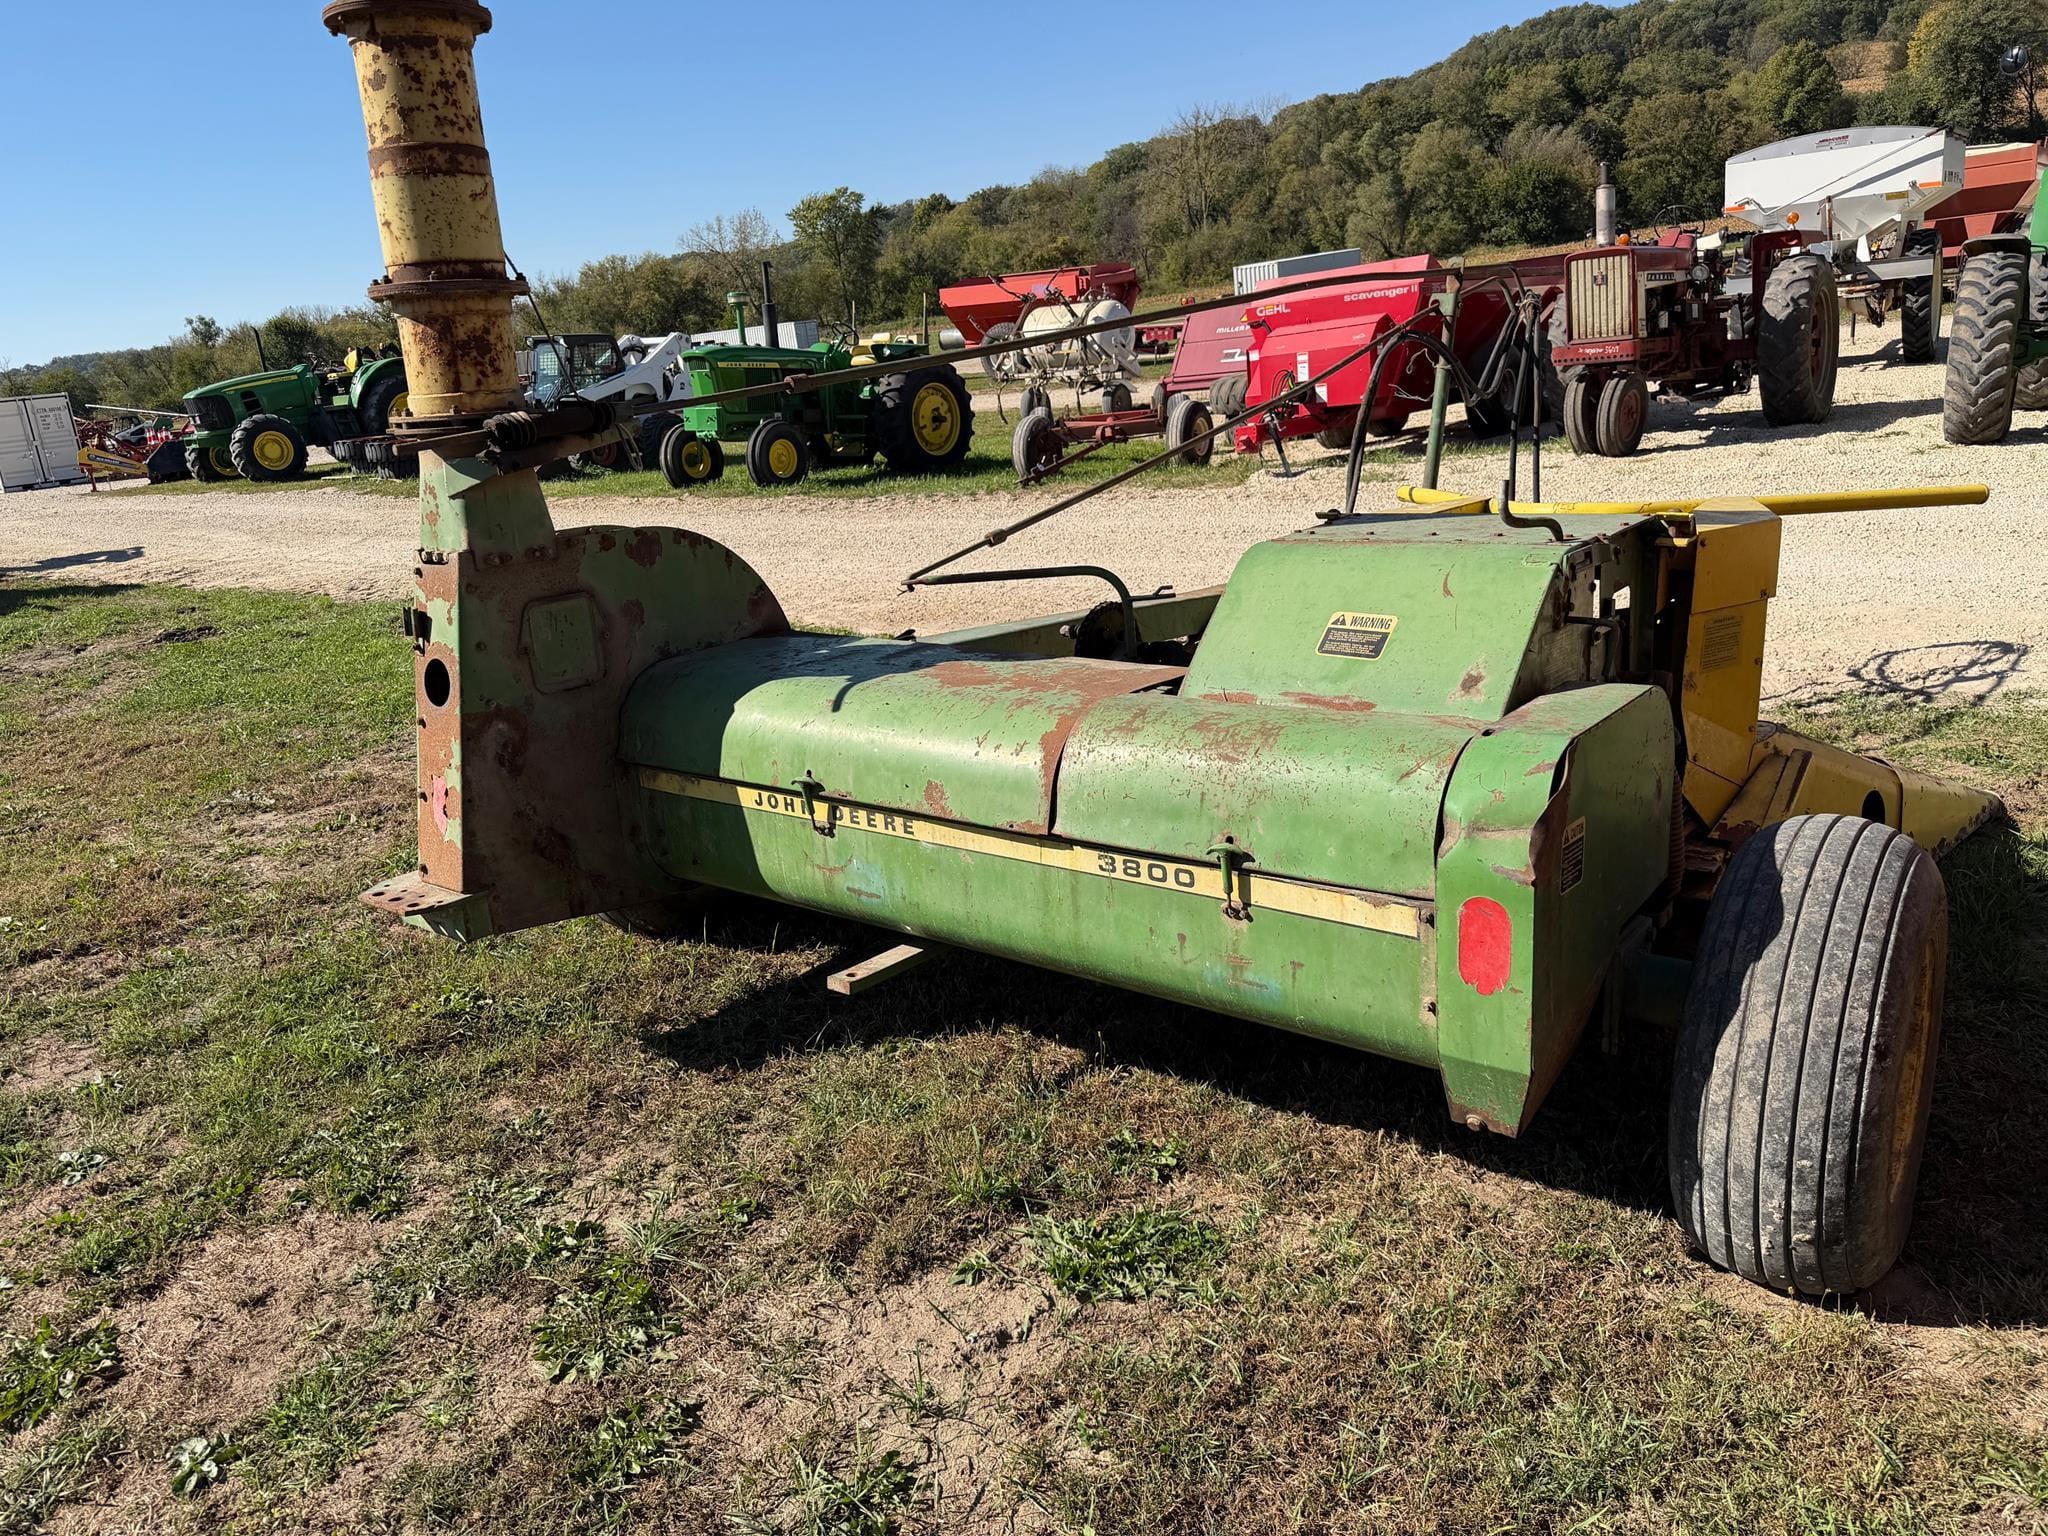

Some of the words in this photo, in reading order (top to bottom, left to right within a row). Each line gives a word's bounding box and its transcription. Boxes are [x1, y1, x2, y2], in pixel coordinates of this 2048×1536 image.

[1343, 286, 1410, 302] scavenger
[1256, 304, 1291, 317] GEHL
[1216, 325, 1245, 334] MILLER
[1349, 615, 1393, 630] WARNING
[831, 805, 915, 835] DEERE
[1098, 853, 1195, 889] 3800
